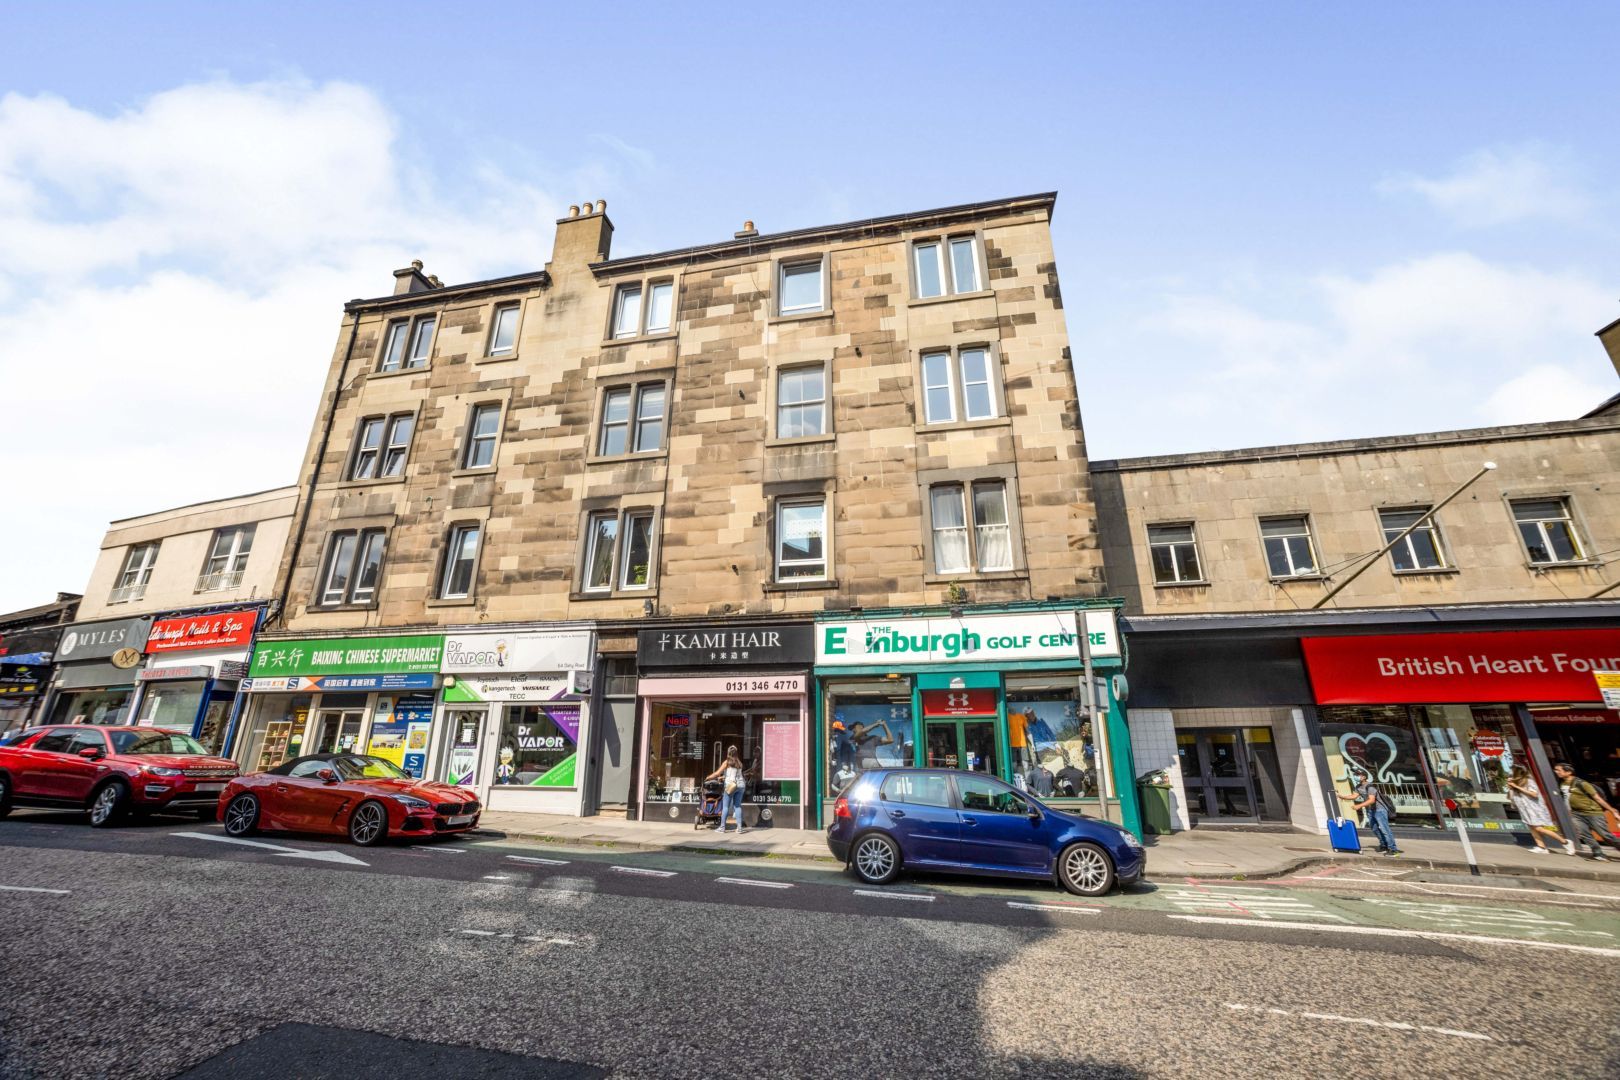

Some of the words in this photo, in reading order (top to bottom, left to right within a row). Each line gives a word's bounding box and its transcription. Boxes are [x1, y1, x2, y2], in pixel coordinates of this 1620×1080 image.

[186, 621, 210, 636] Nails
[212, 621, 221, 632] &
[223, 618, 243, 636] Spa
[872, 626, 891, 634] THE
[77, 628, 126, 646] MYLES
[673, 633, 726, 649] KAMI
[732, 632, 782, 648] HAIR
[986, 635, 1032, 649] GOLF
[1038, 632, 1106, 647] CENRE
[447, 640, 462, 652] Dr
[257, 647, 304, 668] 百兴行
[311, 650, 344, 665] BAIXING
[345, 649, 380, 664] CHINESE
[381, 647, 441, 663] SUPERMARKET
[447, 652, 497, 664] VAPOR
[1377, 655, 1464, 676] British
[1468, 654, 1549, 674] Heart
[726, 681, 748, 691] 0131
[751, 681, 769, 690] 346
[774, 680, 798, 690] 4770
[518, 725, 531, 735] Dr
[517, 737, 565, 748] VAPOR
